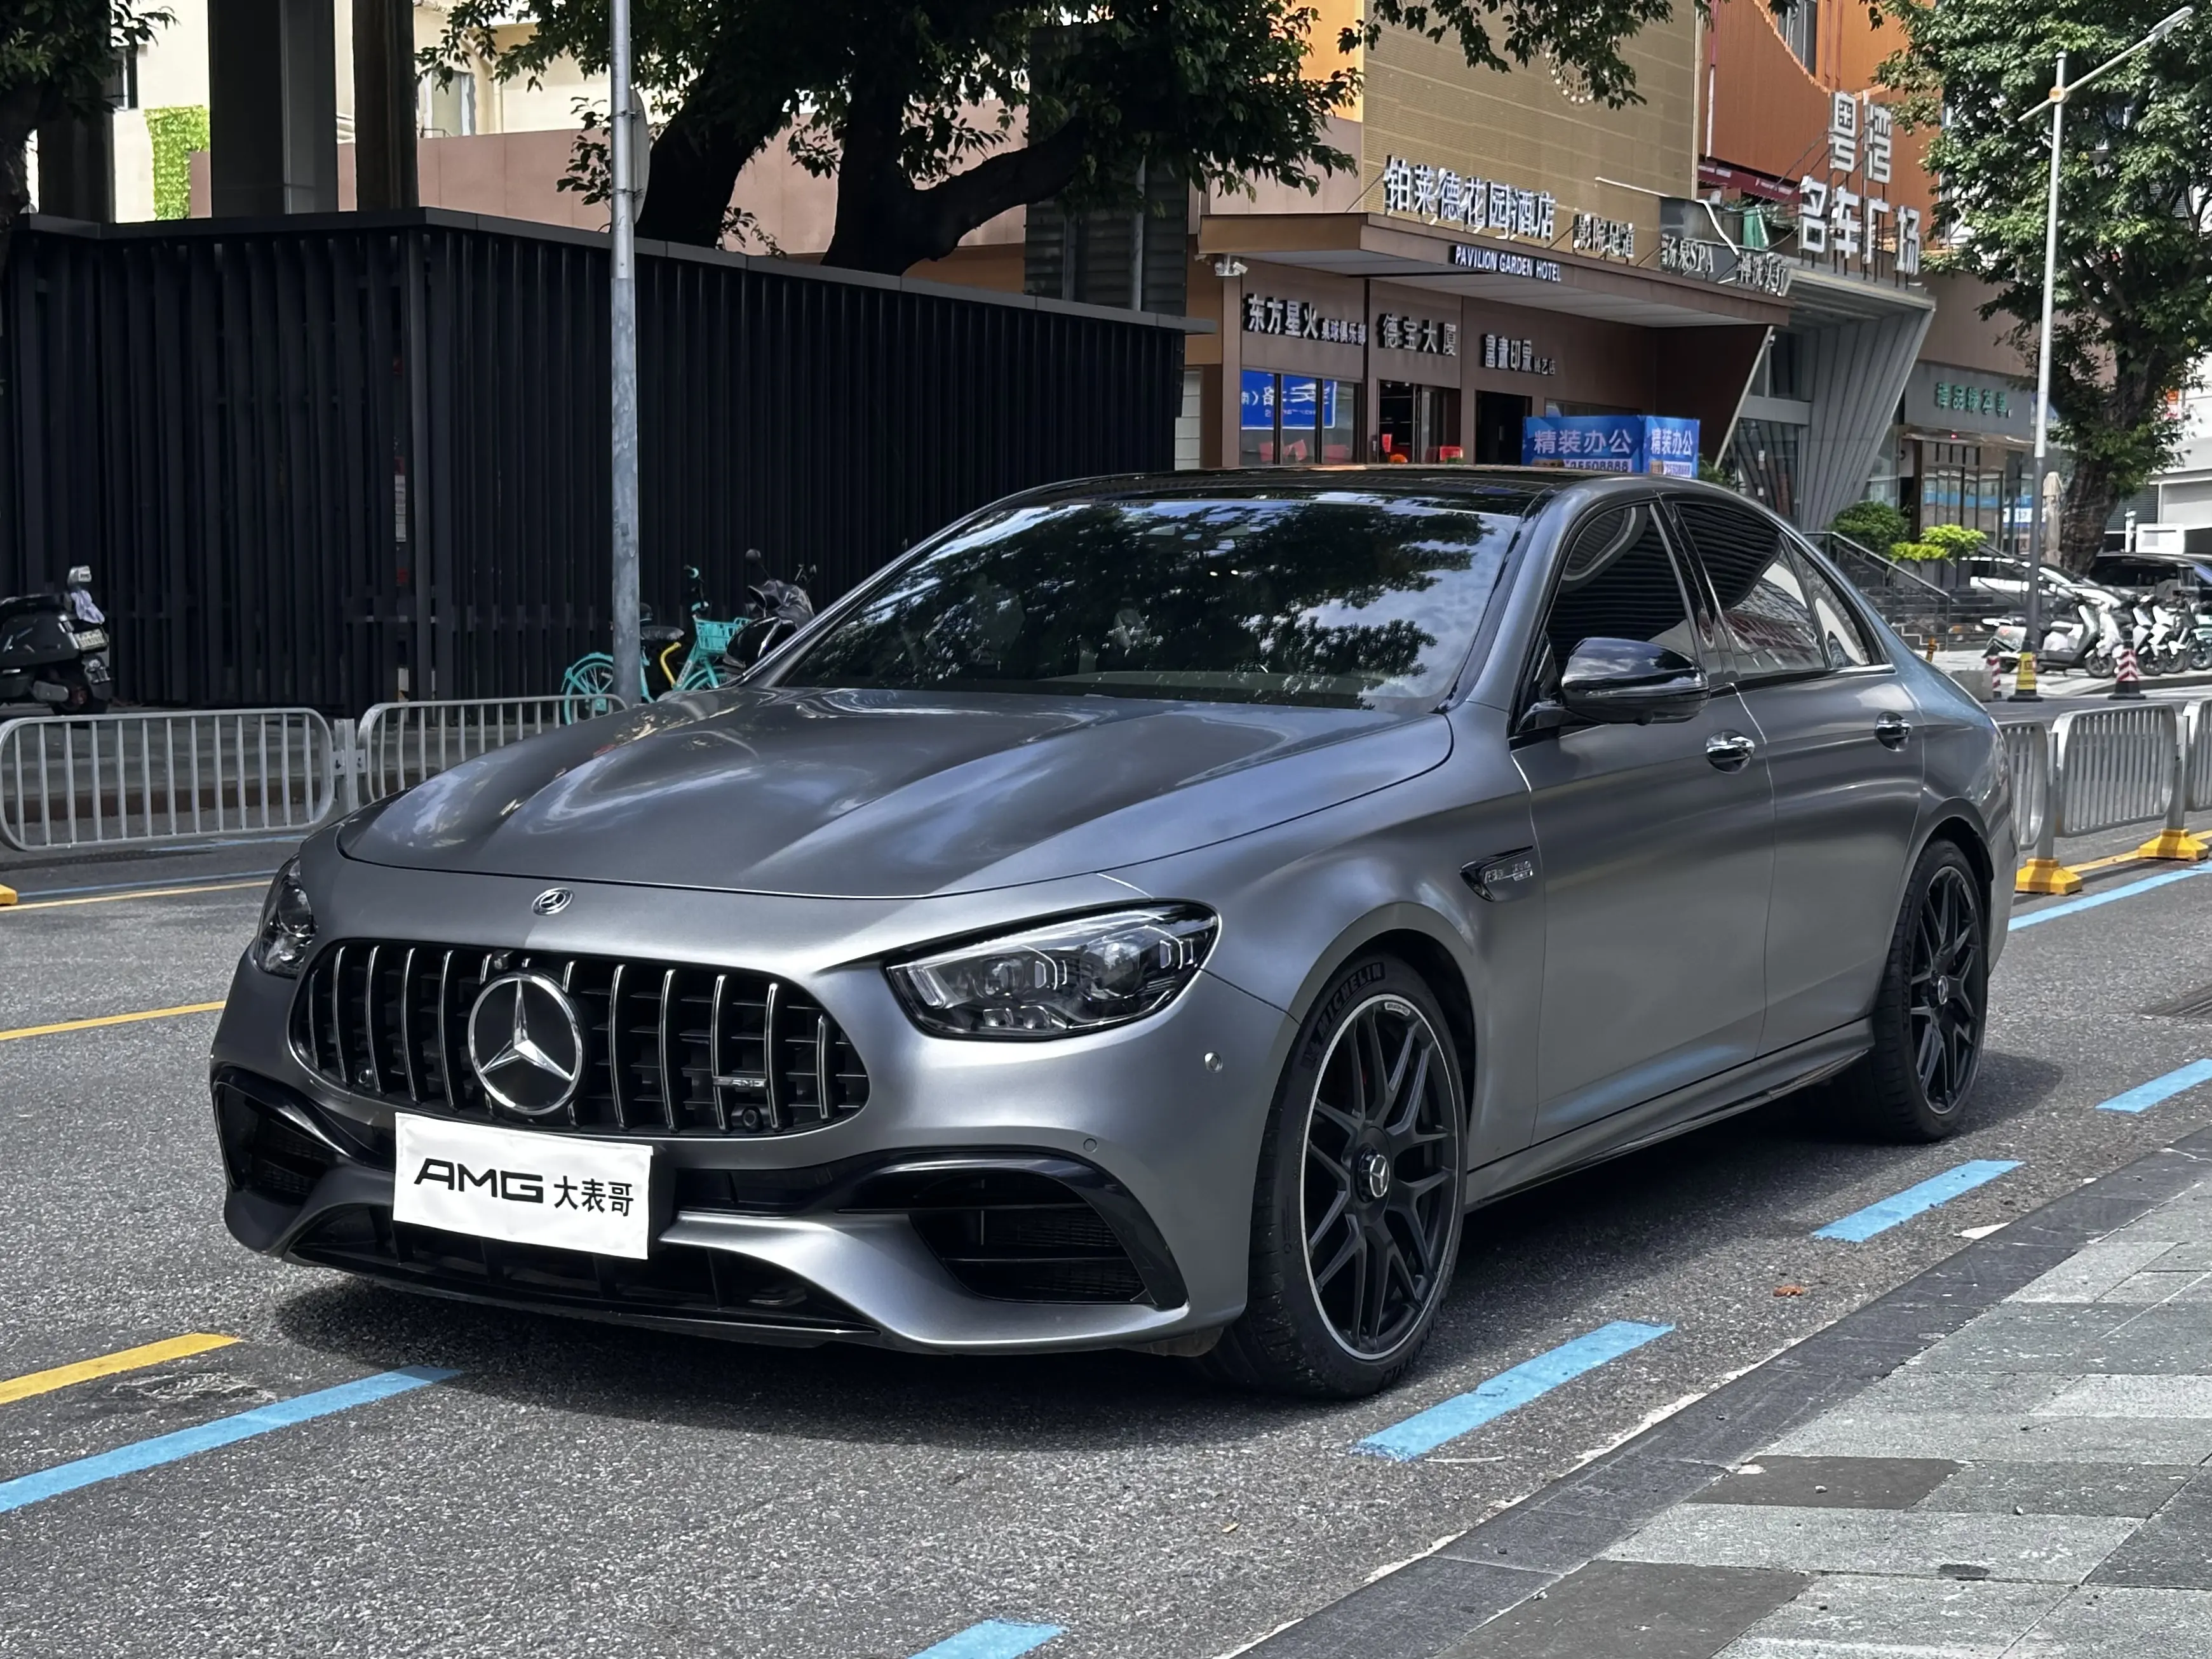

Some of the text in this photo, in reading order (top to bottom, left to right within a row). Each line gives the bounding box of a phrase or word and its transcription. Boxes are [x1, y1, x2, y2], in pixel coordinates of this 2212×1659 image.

[1384, 156, 1556, 241] 铂莱德花园酒店
[1573, 213, 1635, 258] 影院足道
[1798, 175, 1920, 275] 名车广场
[1455, 245, 1561, 282] PAVILION GARDEN HOTEL
[1249, 293, 1318, 339] 东方星火
[1383, 314, 1456, 356] 德宝大厦
[1534, 429, 1632, 455] 精装办公
[1650, 428, 1694, 456] 精装办公
[1317, 963, 1382, 1037] MICHELIN
[414, 1157, 634, 1217] AMG 大表哥
